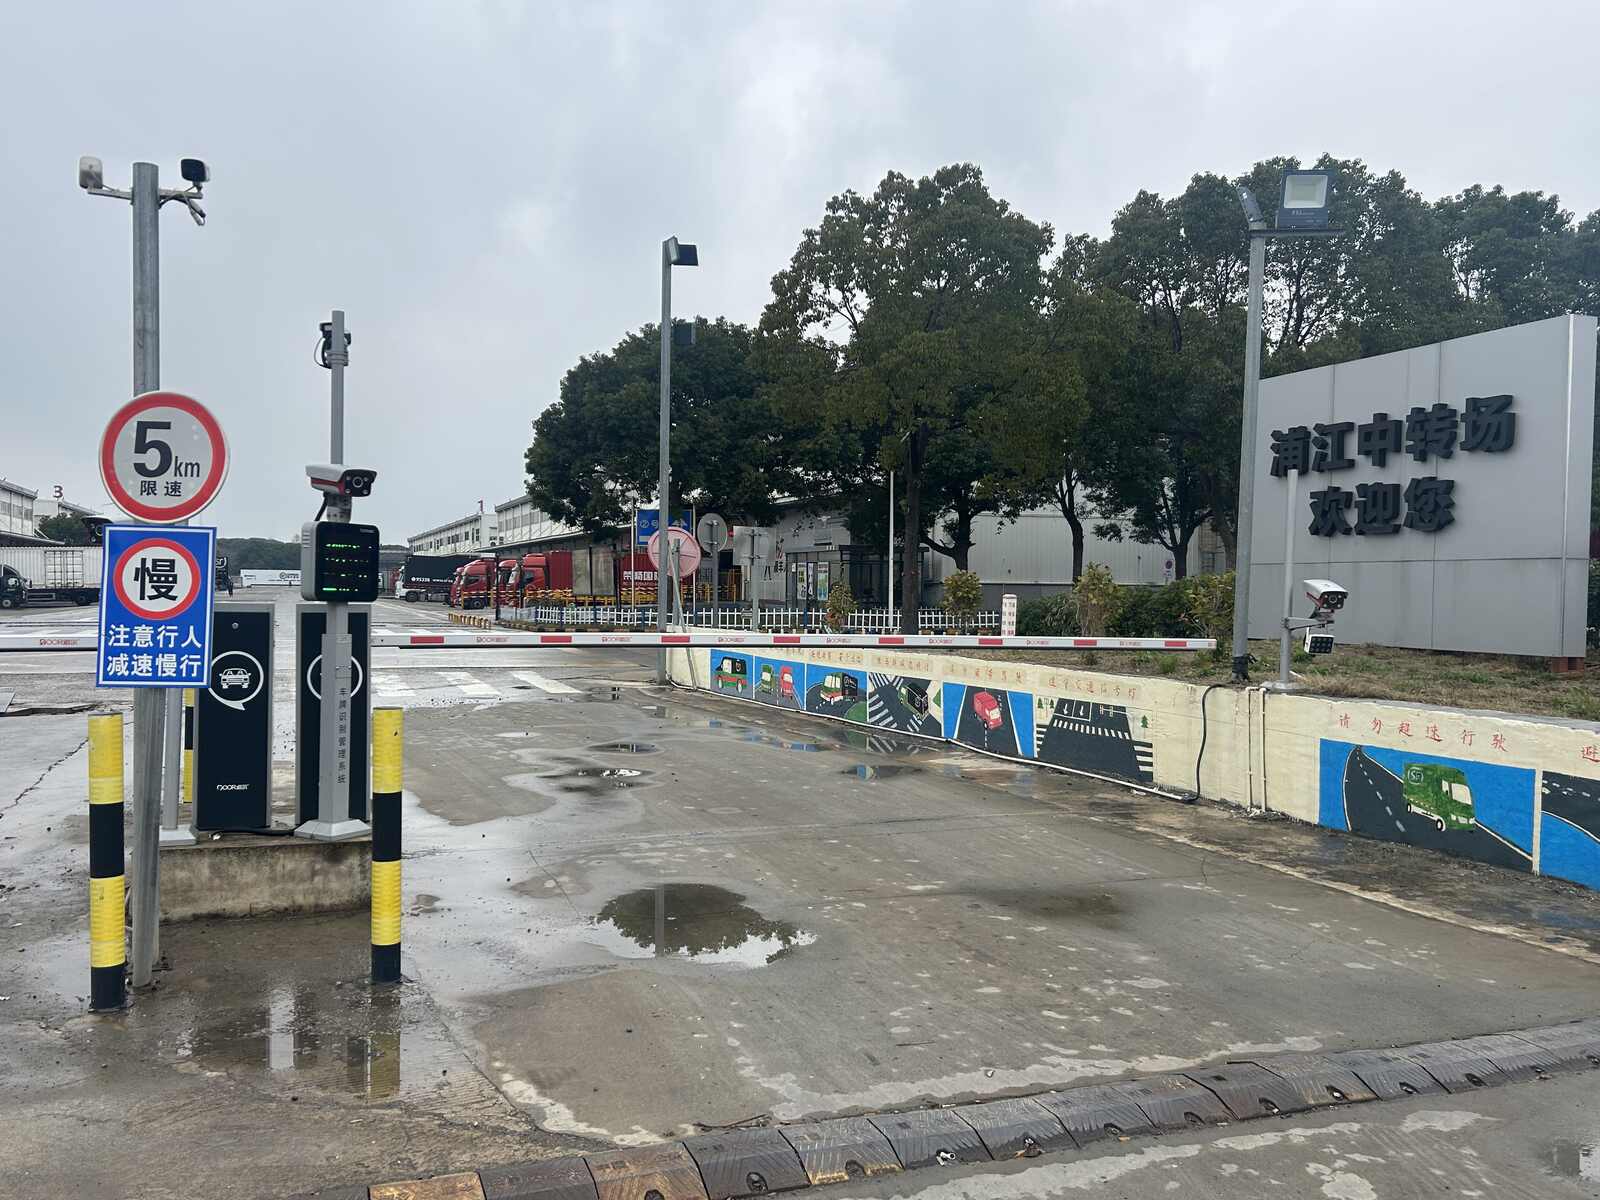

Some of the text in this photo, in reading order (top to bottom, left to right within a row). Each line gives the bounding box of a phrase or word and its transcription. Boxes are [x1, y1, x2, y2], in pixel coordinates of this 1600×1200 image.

[1270, 394, 1516, 477] 浦江中转场
[53, 485, 64, 498] 3
[140, 480, 183, 497] 限速
[1309, 476, 1455, 537] 欢迎您
[134, 557, 179, 601] 慢
[107, 623, 203, 649] 注意行人
[106, 652, 202, 679] 减速慢行
